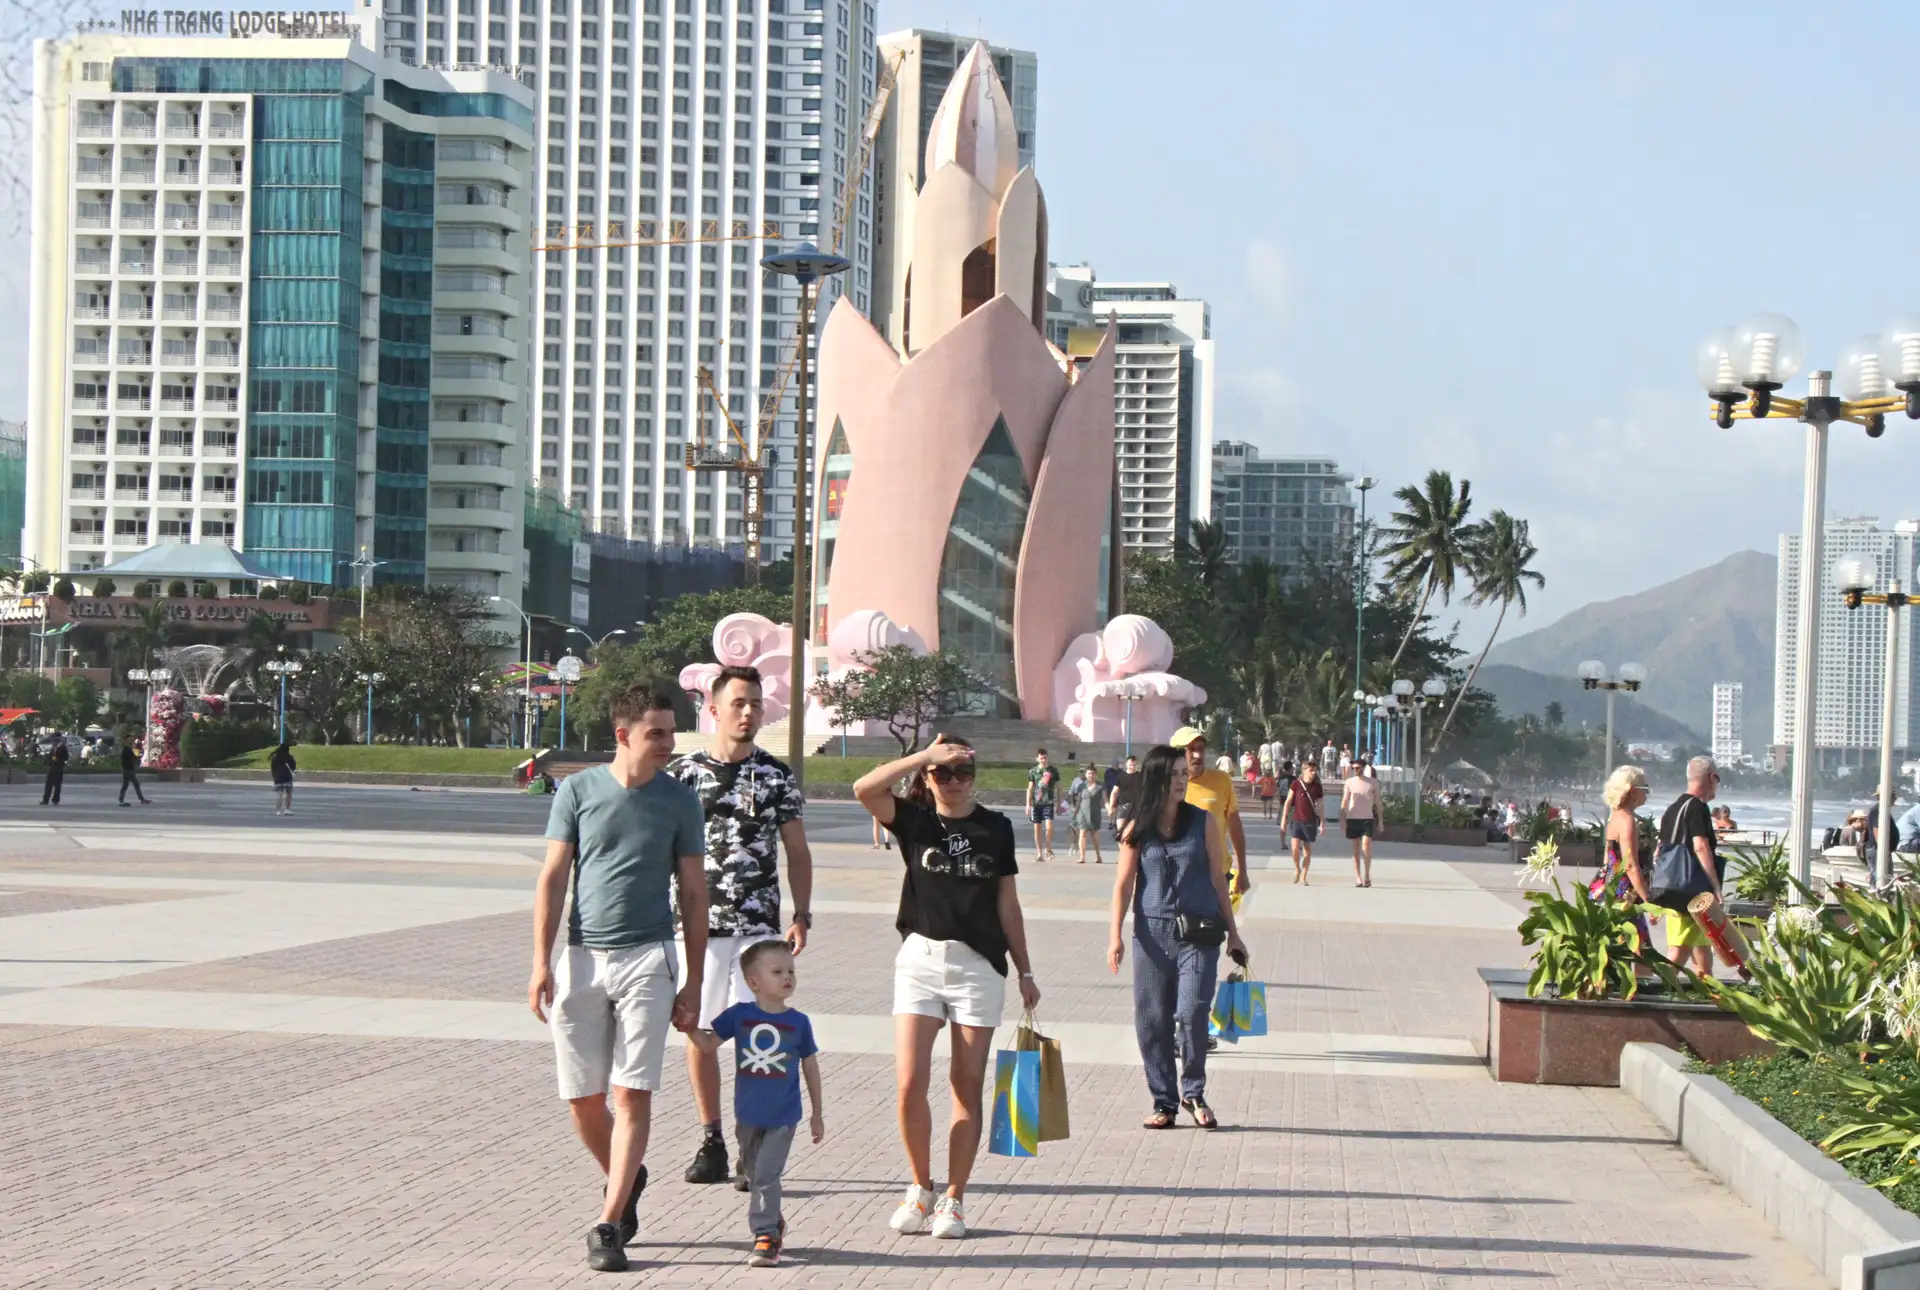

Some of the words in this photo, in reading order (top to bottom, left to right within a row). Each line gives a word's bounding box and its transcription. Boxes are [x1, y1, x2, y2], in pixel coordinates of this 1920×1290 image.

[121, 10, 158, 35] NHA
[163, 10, 223, 36] TRANG
[229, 10, 286, 35] LODGE
[291, 11, 348, 35] HOTEL
[67, 601, 113, 618] NHA
